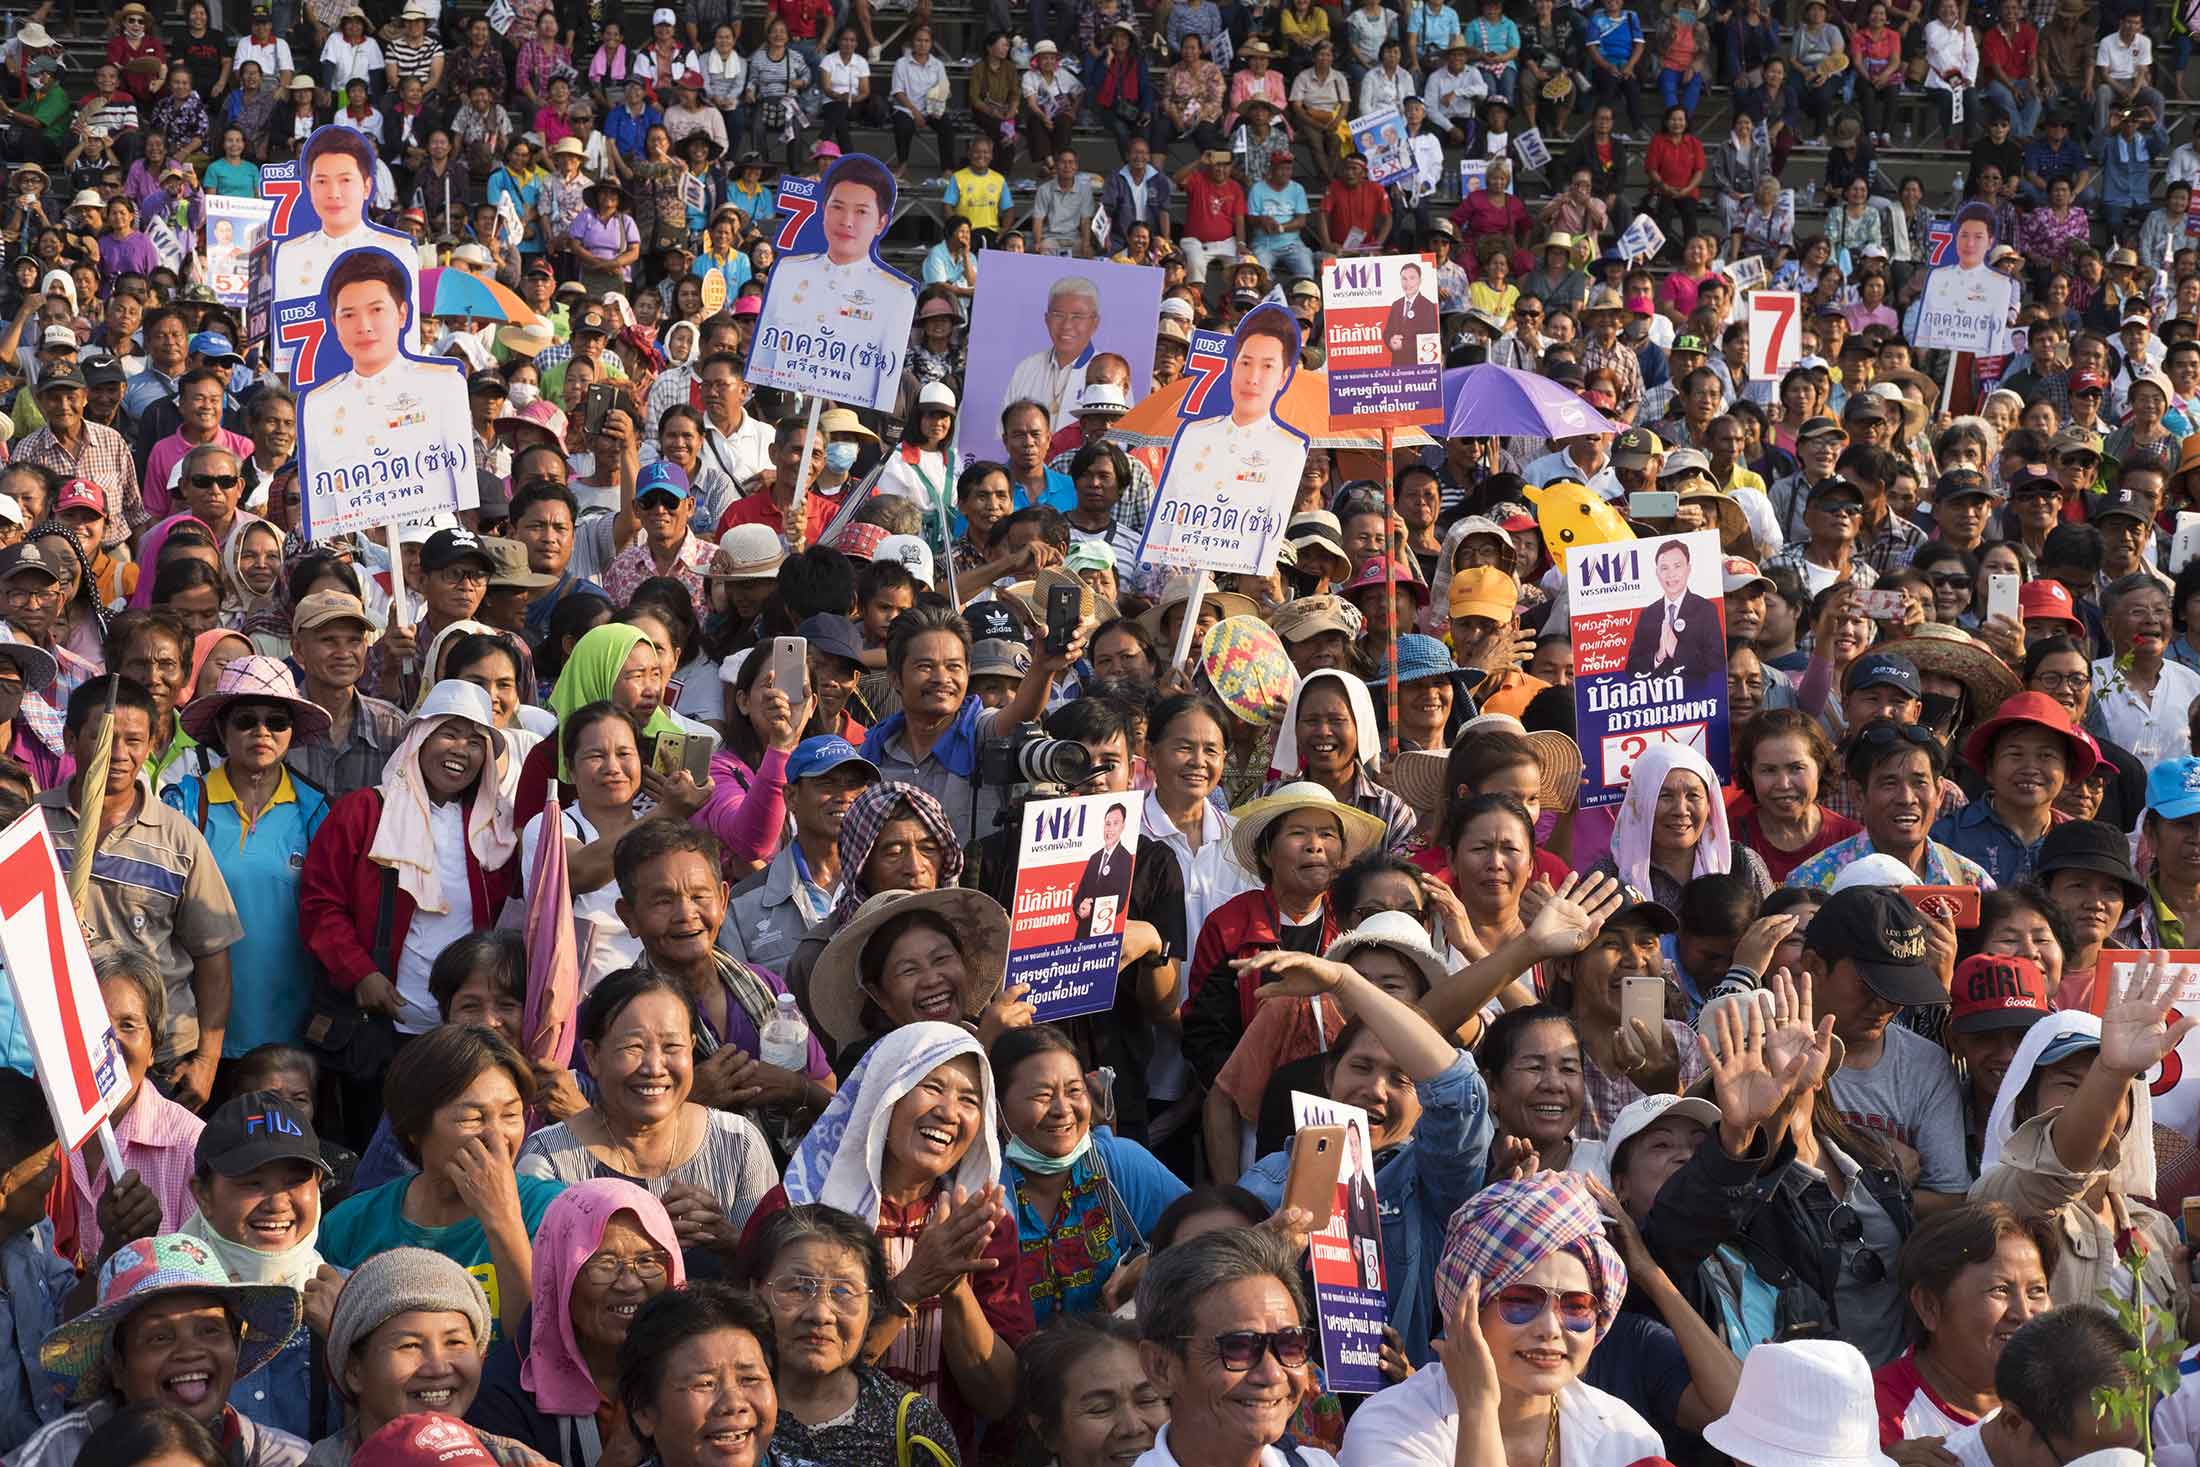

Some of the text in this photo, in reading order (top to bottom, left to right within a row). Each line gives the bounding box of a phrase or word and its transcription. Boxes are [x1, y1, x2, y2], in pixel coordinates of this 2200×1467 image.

[263, 163, 294, 179] เบอร์
[782, 180, 816, 196] เบอร์
[262, 180, 303, 236] 7
[776, 193, 818, 251] 7
[1929, 232, 1953, 266] 7
[215, 275, 232, 291] 5
[1332, 262, 1382, 290] พท
[281, 302, 316, 321] เบอร์
[1195, 338, 1227, 354] เบอร์
[1329, 321, 1383, 344] บัลลังก์
[1754, 296, 1796, 375] 7
[281, 319, 327, 385] 7
[761, 325, 896, 377] ภาควัต (ซัน)
[1419, 342, 1439, 364] 3
[786, 357, 851, 382] ศรีสุรพล
[1189, 352, 1229, 415] 7
[314, 442, 467, 497] ภาควัต (ซัน)
[350, 484, 425, 508] ศรีสุรพล
[1160, 493, 1282, 540] ภาควัต (ซัน)
[1181, 529, 1240, 552] ศรีสุรพล
[1579, 549, 1640, 587] พท
[985, 625, 1013, 635] adidas
[1586, 665, 1686, 713] บัลลังก์
[1607, 698, 1718, 732] อรรณนพพร
[1035, 804, 1088, 842] พท
[1017, 882, 1076, 914] บัลลังก์
[1092, 906, 1114, 935] 3
[0, 831, 100, 1116] 7
[1082, 951, 1118, 972] คนแก้
[1967, 962, 2036, 1001] GIRL
[247, 1111, 303, 1137] FILA
[1367, 1254, 1379, 1289] 3
